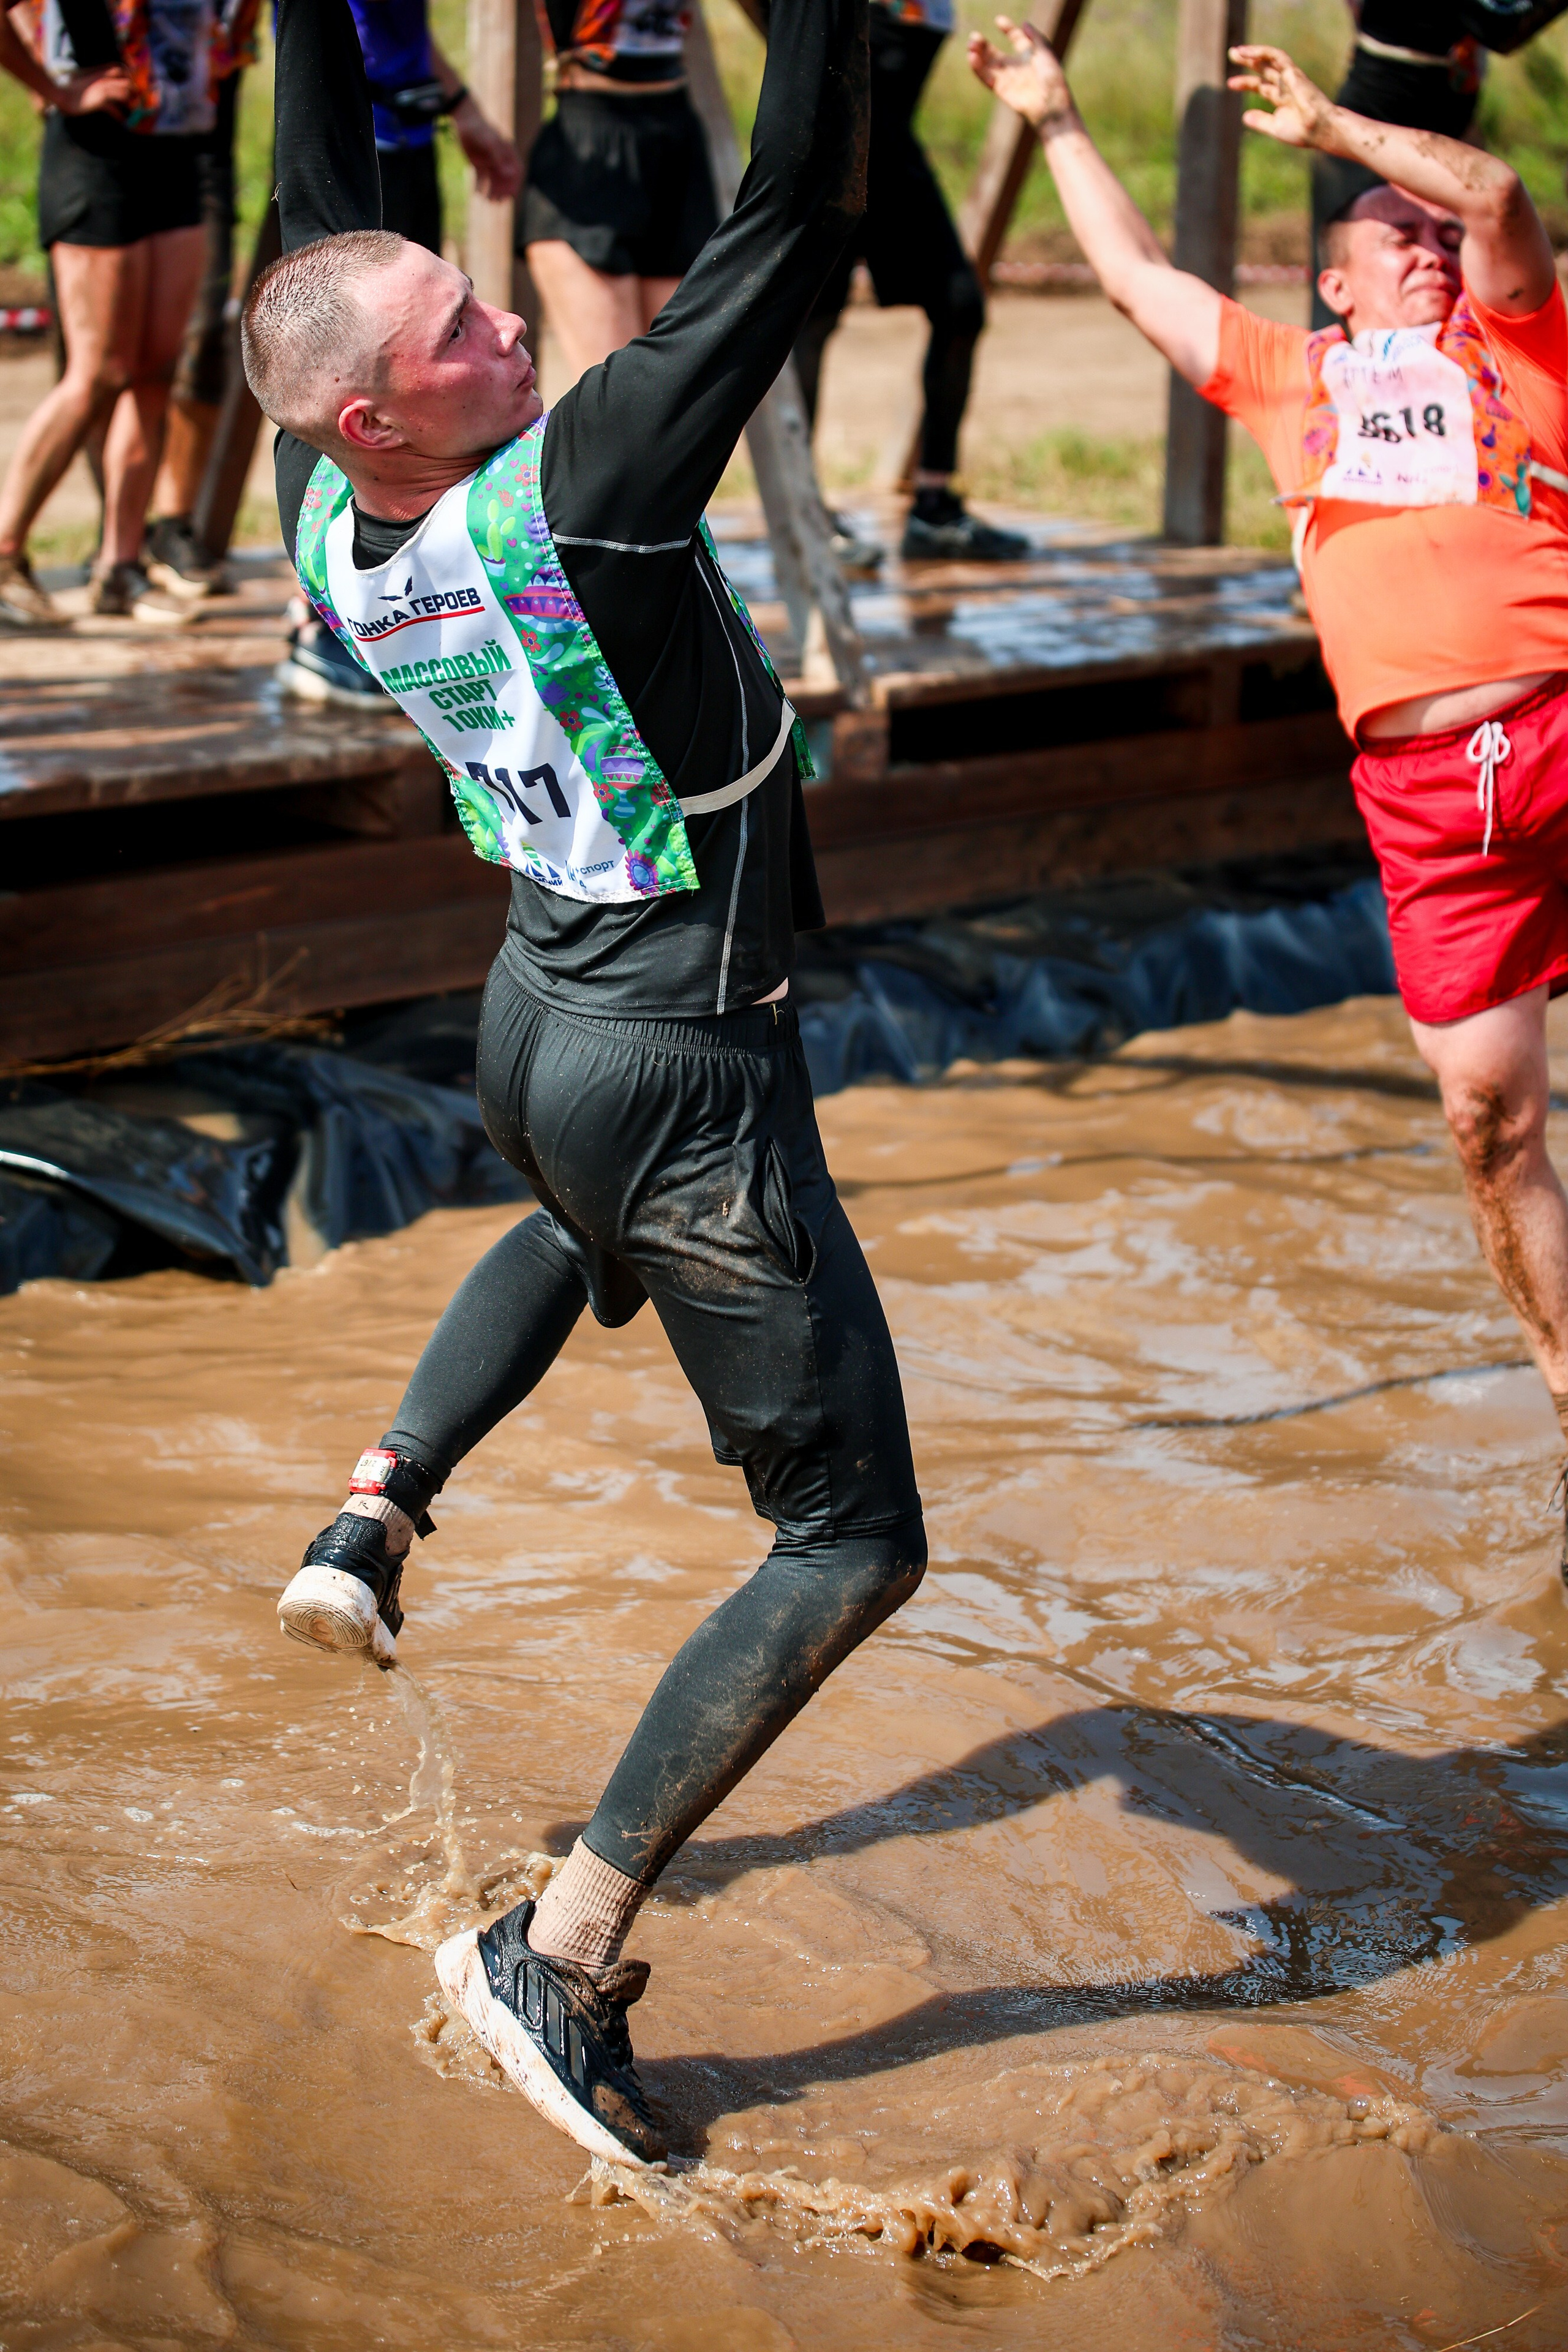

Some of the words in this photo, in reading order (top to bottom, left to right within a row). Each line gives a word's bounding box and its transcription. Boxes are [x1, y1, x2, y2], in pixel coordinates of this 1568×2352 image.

[409, 587, 481, 616] ГЕРОЕВ
[379, 639, 513, 693] МАССОВЫЙ
[429, 679, 498, 710] СТАРТ
[464, 761, 571, 826] 717
